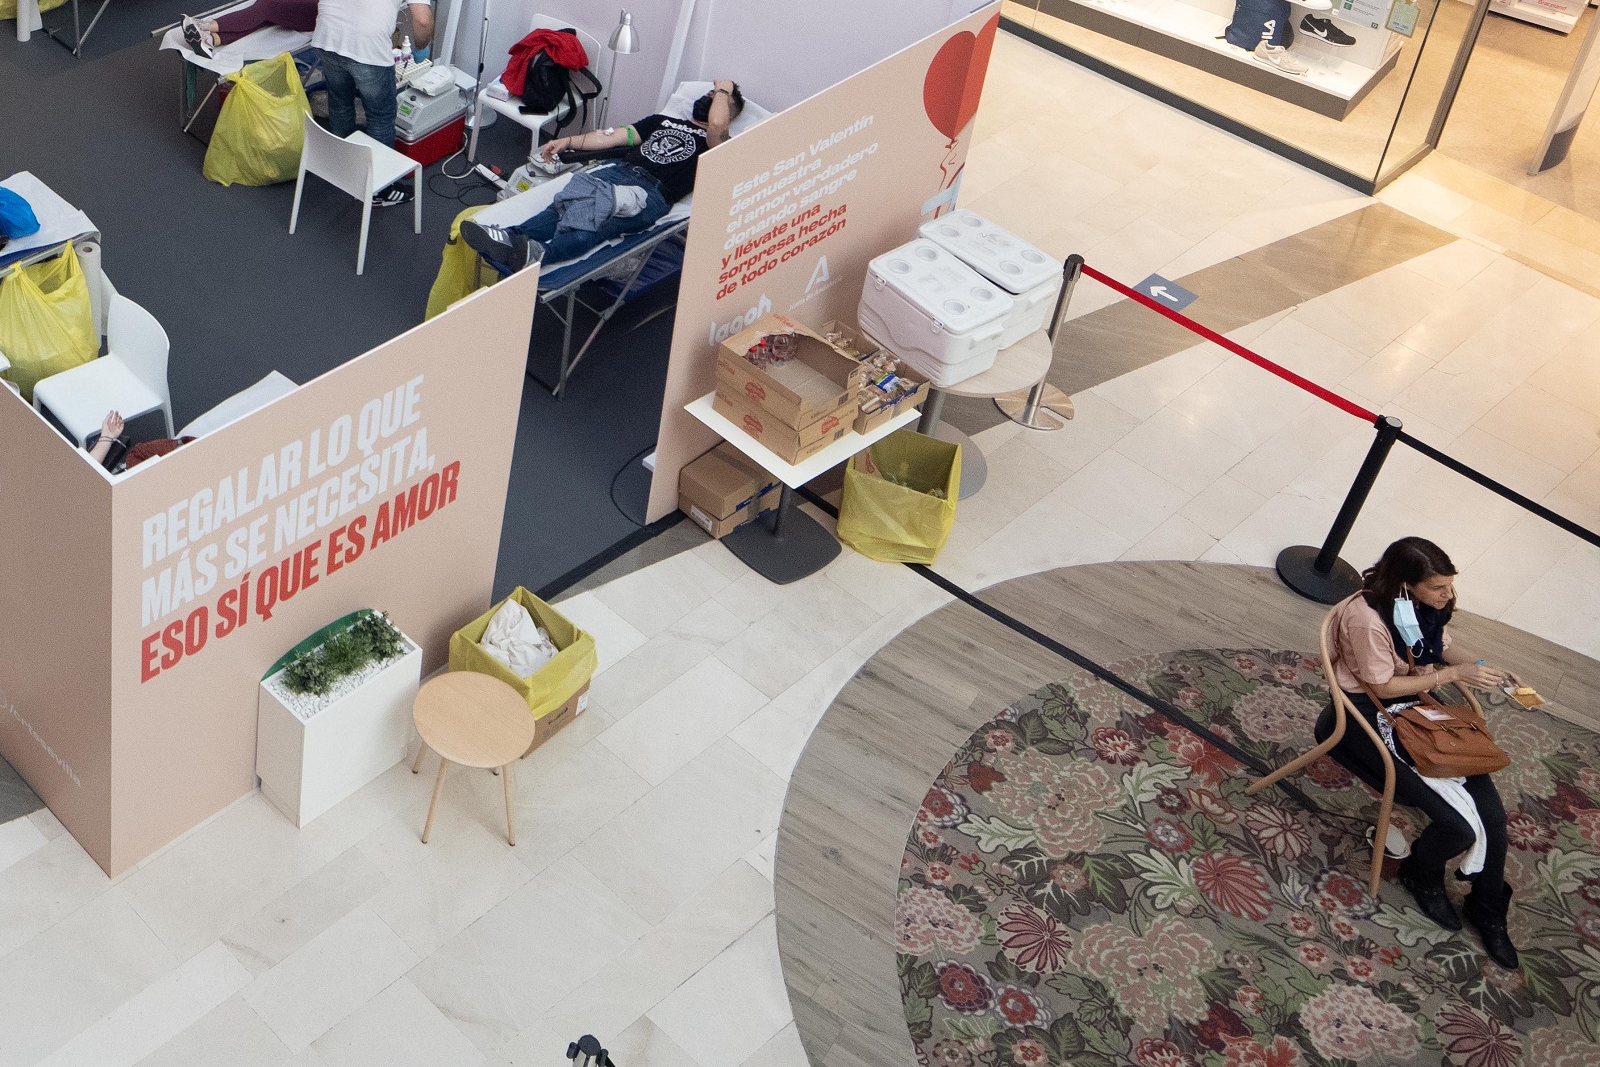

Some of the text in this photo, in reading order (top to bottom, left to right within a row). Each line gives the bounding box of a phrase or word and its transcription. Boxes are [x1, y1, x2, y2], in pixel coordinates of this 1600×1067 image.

[1538, 0, 1567, 11] Graceland
[726, 142, 879, 234] el amor verdadero
[729, 158, 822, 217] demuestra
[731, 114, 874, 200] Este San Valentín
[718, 204, 847, 284] sorpresa hecha
[720, 204, 821, 270] y llévate una
[723, 169, 857, 250] donando sangre
[716, 218, 847, 300] de todo corazón
[142, 374, 425, 570] REGALAR LO QUE
[142, 427, 436, 628] MÁS SE NECESITA,
[141, 460, 460, 684] ESO SÍ QUE ES AMOR
